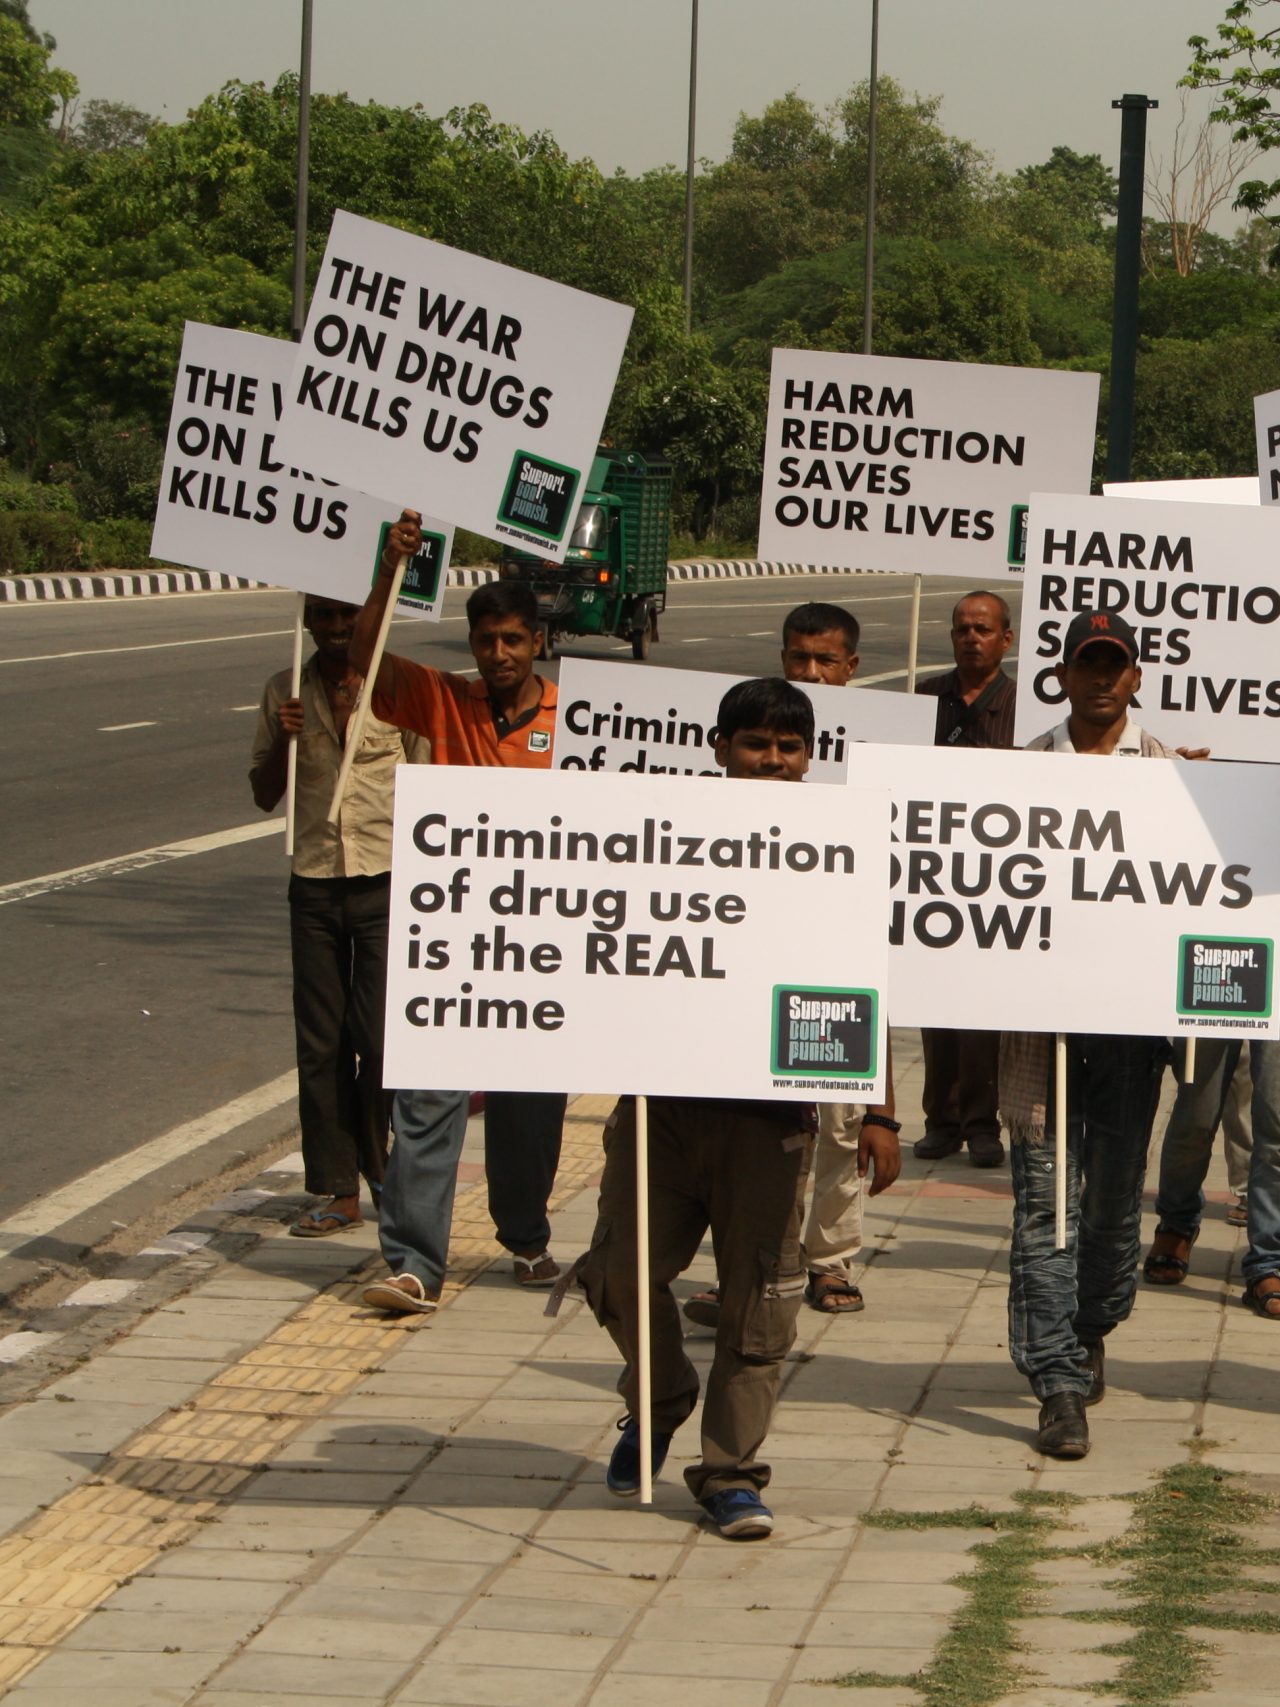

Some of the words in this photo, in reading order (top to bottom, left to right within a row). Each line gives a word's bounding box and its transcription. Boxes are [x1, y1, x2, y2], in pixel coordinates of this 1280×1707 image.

[329, 257, 406, 320] THE
[419, 287, 522, 361] WAR
[185, 364, 258, 416] THE
[314, 314, 387, 372] ON
[395, 341, 553, 428] DRUGS
[297, 365, 412, 438] KILLS
[424, 408, 482, 463] US
[784, 379, 913, 419] HARM
[177, 417, 246, 465] ON
[781, 418, 1025, 466] REDUCTION
[520, 461, 565, 499] Support.
[778, 457, 910, 496] SAVES
[169, 466, 278, 524] KILLS
[293, 493, 348, 540] US
[775, 496, 868, 531] OUR
[885, 504, 994, 541] LIVES
[1043, 529, 1193, 572] HARM
[1035, 620, 1190, 665] SES
[413, 813, 854, 873] Criminalization
[410, 868, 470, 913] of
[490, 870, 626, 932] drug
[651, 892, 746, 924] use
[1072, 858, 1252, 908] LAWS
[409, 924, 449, 970] is
[471, 926, 561, 973] the
[586, 933, 725, 978] REAL
[1193, 944, 1258, 980] Support.
[406, 983, 564, 1030] crime
[789, 995, 861, 1036] Support.
